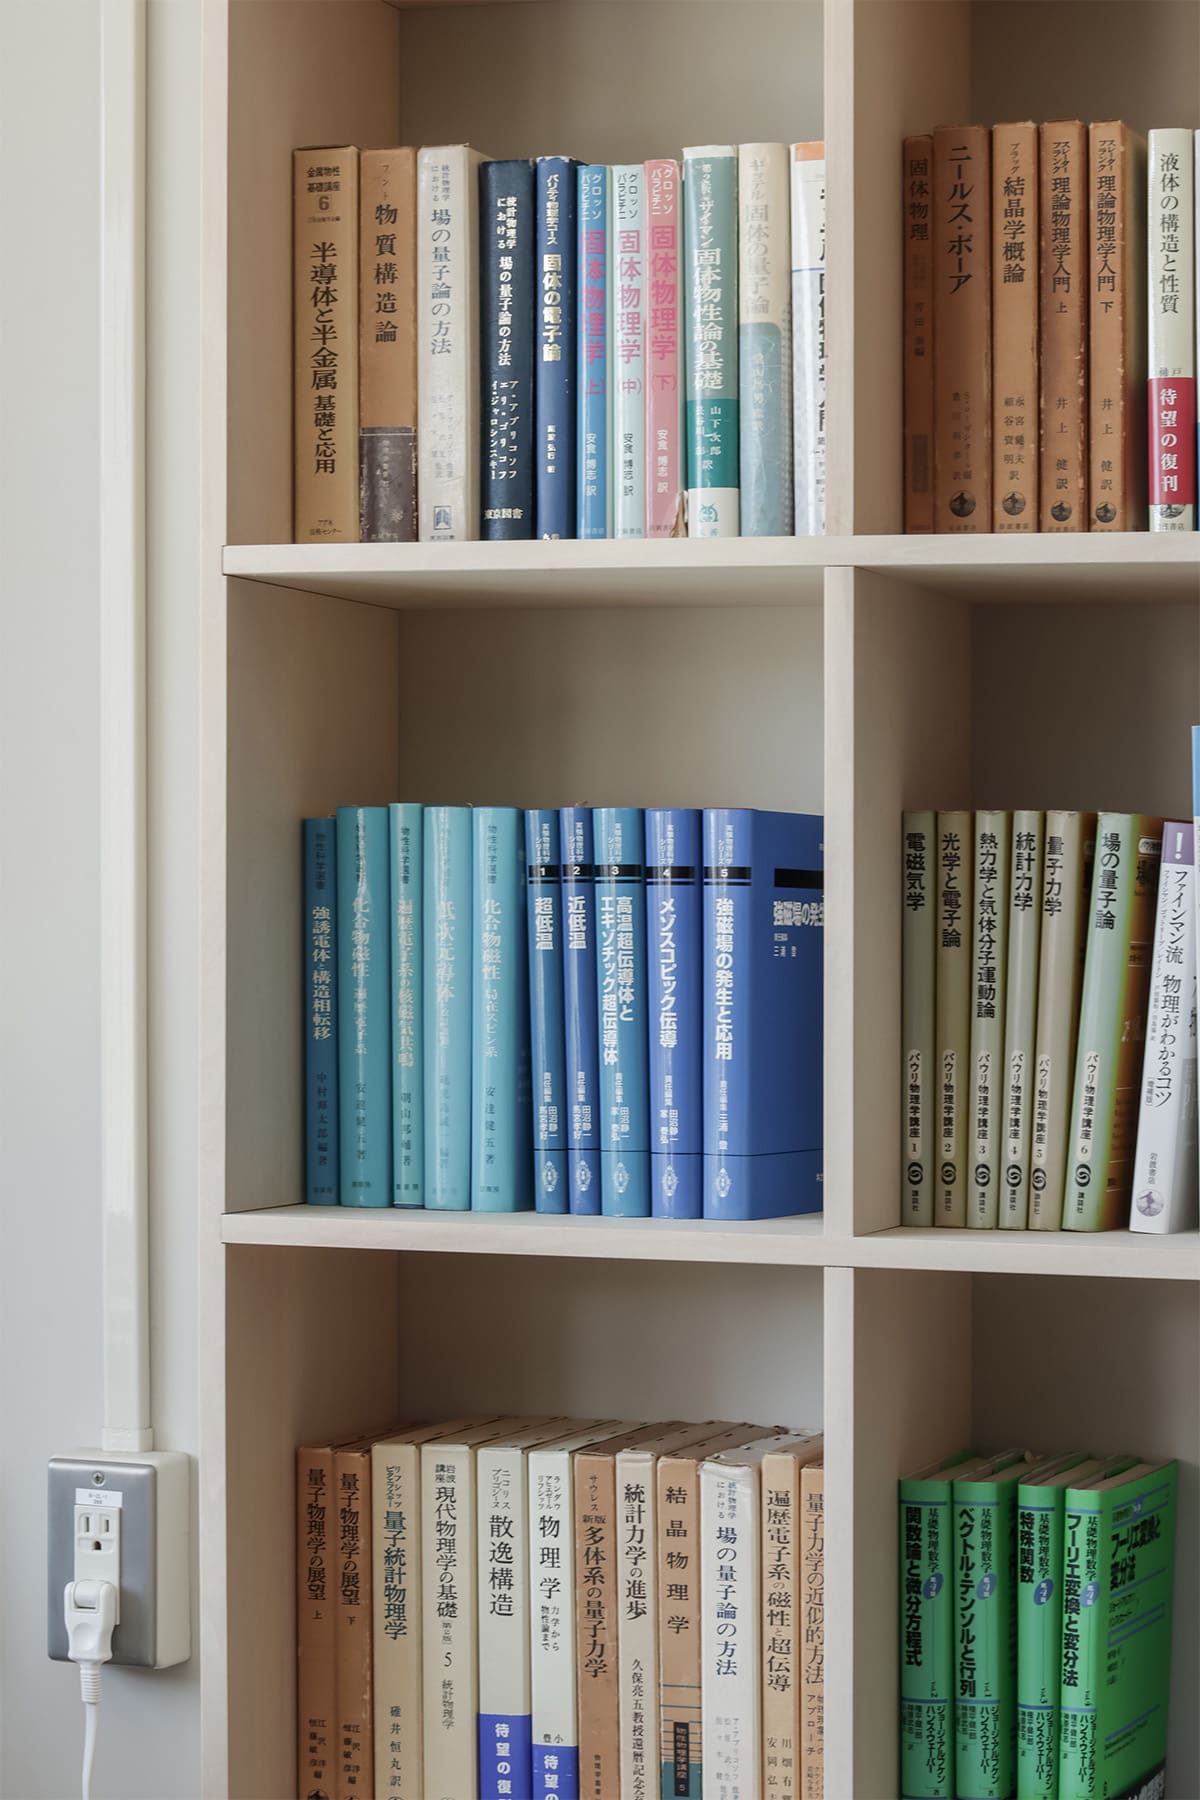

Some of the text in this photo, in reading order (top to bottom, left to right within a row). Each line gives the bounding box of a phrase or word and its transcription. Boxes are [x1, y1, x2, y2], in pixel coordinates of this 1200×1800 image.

[307, 166, 340, 177] 金属物性
[307, 182, 340, 192] 基礎講座
[318, 196, 329, 211] 6
[497, 198, 506, 249] における
[628, 173, 638, 218] グロッソ
[910, 158, 929, 240] 固体物理
[948, 145, 974, 295] ニールス・ボーア
[375, 204, 398, 342] 物質構造論
[431, 209, 452, 355] 場の量子論の方法
[745, 204, 770, 314] 固体の量子論
[1002, 176, 1026, 284] 結晶学概論
[1052, 176, 1072, 314] 理論物理学入門 上
[1096, 175, 1117, 314] 理論物理学入門 下
[1160, 152, 1180, 314] 液体の構造と性質
[498, 256, 513, 366] 場の量子論の方法
[542, 254, 562, 362] 固体の電子論
[581, 230, 604, 365] 固体物理学
[619, 230, 642, 365] 固体物理学
[652, 225, 676, 361] 固体物理学
[694, 248, 724, 390] 固体物性論の基礎
[310, 242, 338, 474] 半導体と半金属 基礎と応用
[1160, 388, 1178, 492] 待望の復刊
[534, 896, 554, 950] 超低温
[539, 867, 546, 876] 1
[568, 896, 587, 950] 近低温
[573, 866, 581, 876] 2
[611, 866, 620, 875] 3
[663, 868, 671, 877] 4
[720, 868, 728, 878] 5
[906, 832, 926, 912] 電磁気学
[942, 832, 962, 948] 光学と電子論
[1014, 832, 1036, 912] 統計力学
[1044, 836, 1064, 917] 量子力学
[1094, 832, 1121, 930] 場の量子論
[1166, 870, 1188, 965] ファインマン流
[312, 906, 332, 1040] 強誘電体と構造相転移
[352, 896, 370, 978] 化合物磁性
[482, 898, 502, 980] 化合物磁性
[616, 896, 634, 1022] 高温超伝導体と
[660, 898, 678, 1048] メゾスコピック伝導
[715, 898, 734, 1060] 強磁場の発生と応用
[976, 832, 998, 1018] 熱力学と気体分子運動論
[602, 896, 618, 1066] エキゾチック超伝導体
[1154, 974, 1182, 1108] 物理がわかるコツ
[909, 1052, 921, 1152] パウリ物理学講座 1
[943, 1052, 955, 1152] パウリ物理学講座 2
[977, 1054, 990, 1154] パウリ物理学講座 3
[1009, 1053, 1024, 1154] パウリ物理学講座 4
[1036, 1058, 1050, 1158] パウリ物理学講座 5
[1080, 1054, 1099, 1154] パウリ物理学講座 6
[306, 1468, 326, 1620] 量子物理学の展望 上
[340, 1473, 360, 1626] 量子物理学の展望 下
[435, 1486, 458, 1618] 現代物理学の基礎
[488, 1514, 514, 1617] 散逸構造
[538, 1514, 560, 1600] 物理学
[582, 1514, 606, 1524] 新版
[624, 1483, 648, 1621] 統計力学の進歩
[666, 1486, 689, 1635] 結晶物理学
[1020, 1512, 1034, 1584] 特殊関数
[384, 1510, 406, 1641] 量子統計物理学
[551, 1606, 560, 1652] 力学から
[583, 1526, 608, 1678] 多体系の量子力学
[716, 1526, 739, 1676] 場の量子論の方法
[766, 1490, 792, 1692] 遍歴電子系の磁性と超伝導
[806, 1493, 824, 1684] 量子力学の近似的方法
[905, 1506, 922, 1666] 関数論と微分方程式
[959, 1508, 976, 1698] ベクトル・テンソルと行列
[1062, 1514, 1082, 1688] フーリエ変換と変分法
[444, 1652, 452, 1668] 5
[495, 1722, 512, 1800] 待望の復
